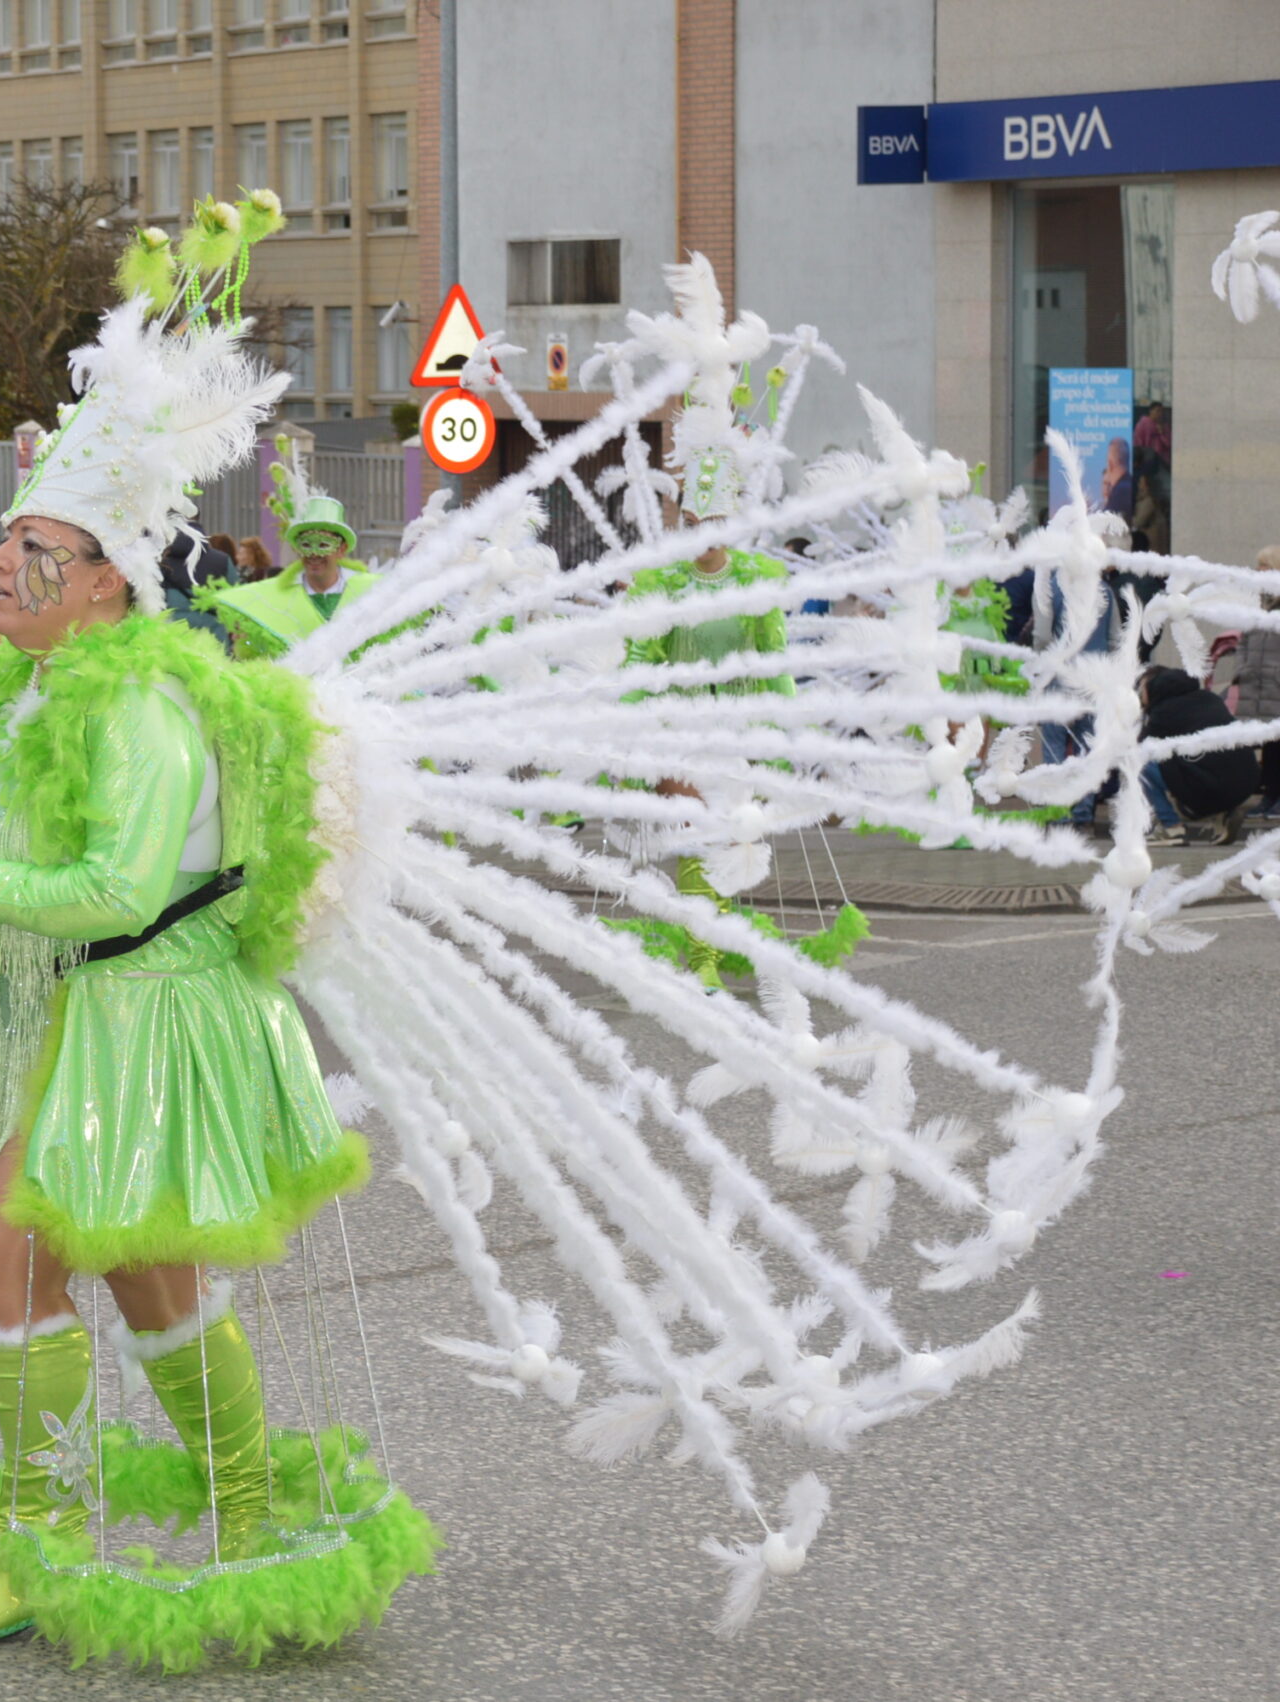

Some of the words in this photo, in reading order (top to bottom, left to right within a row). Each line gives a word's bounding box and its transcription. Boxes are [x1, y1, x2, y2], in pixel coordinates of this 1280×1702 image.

[1004, 105, 1112, 161] BBVA
[869, 134, 920, 155] BBVA
[1079, 370, 1089, 384] el
[1090, 370, 1119, 387] mejor
[1052, 388, 1081, 401] grupo
[1082, 385, 1095, 399] de
[1064, 400, 1130, 416] profesionales
[442, 417, 477, 442] 30
[1083, 414, 1099, 428] del
[1100, 416, 1130, 428] sector
